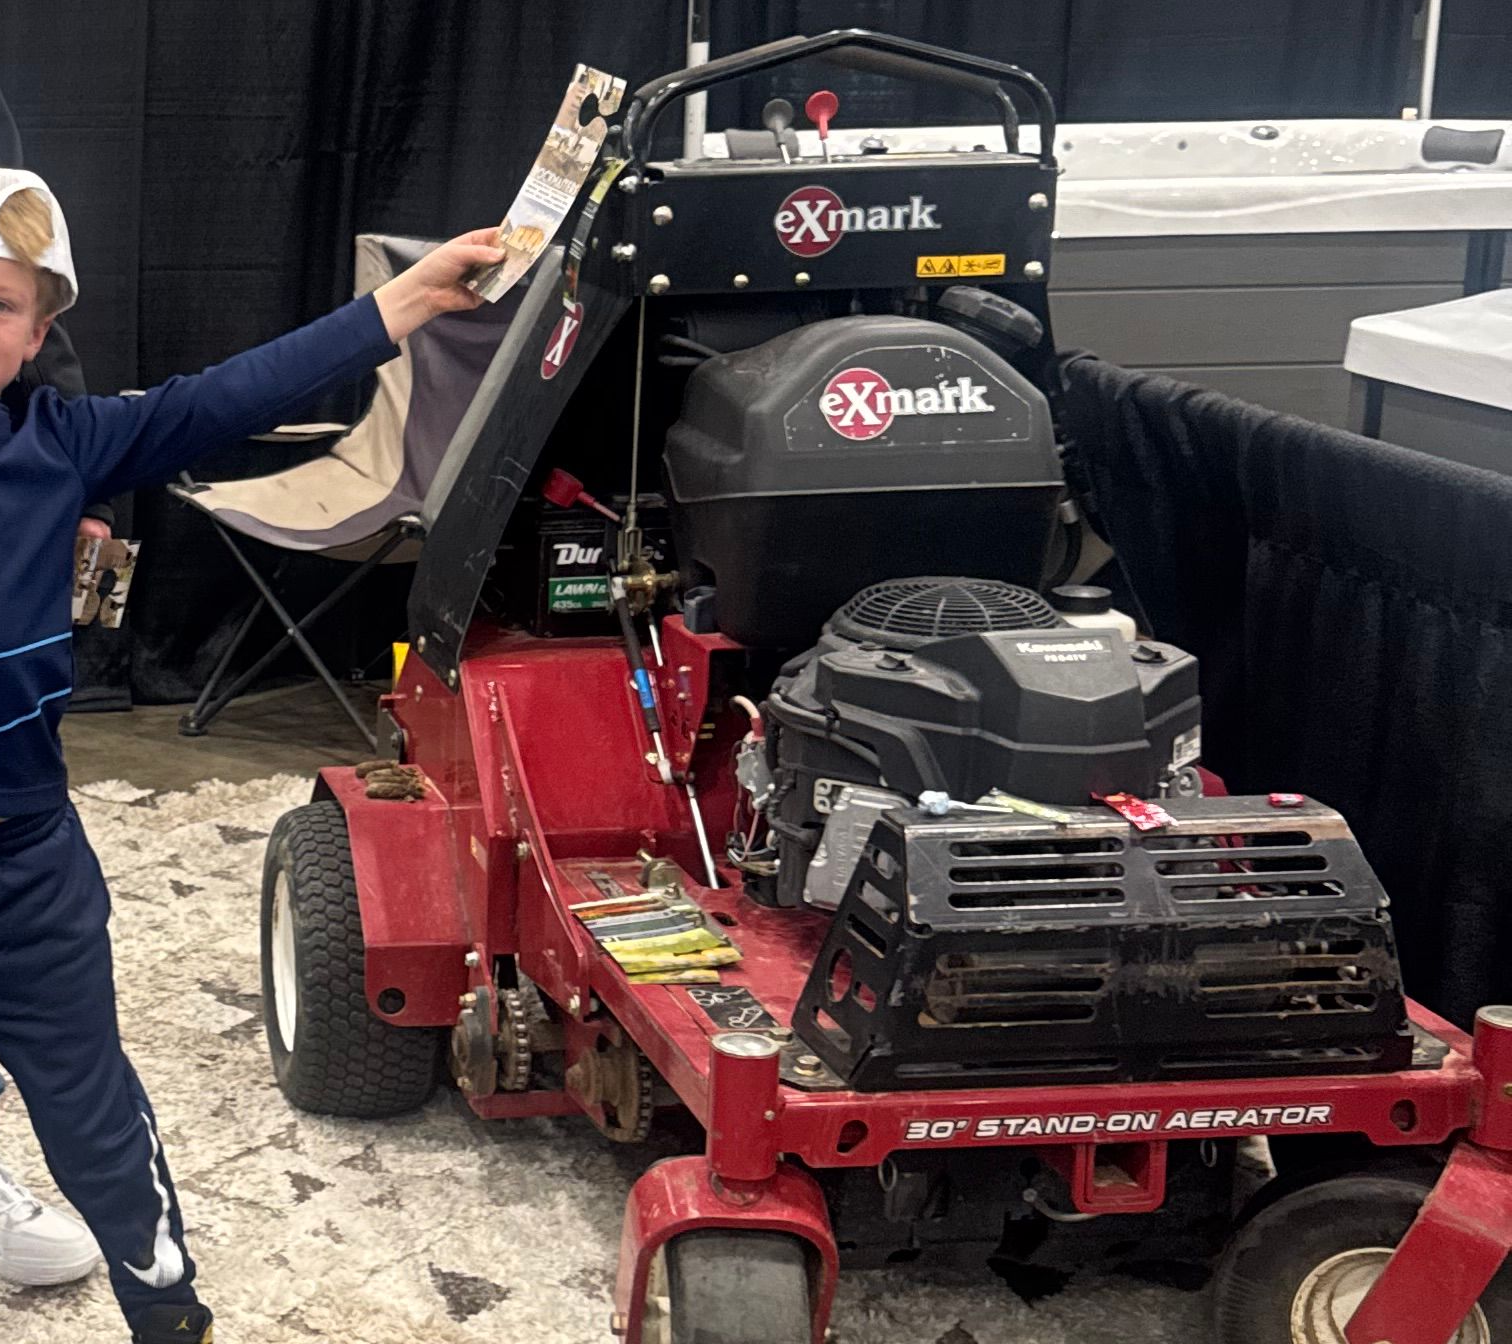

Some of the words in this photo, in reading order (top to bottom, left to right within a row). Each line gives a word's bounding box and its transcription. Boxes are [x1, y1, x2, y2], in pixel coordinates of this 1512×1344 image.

[554, 583, 599, 596] LAWN
[904, 1120, 967, 1141] 30"
[974, 1113, 1157, 1137] STAND-ON
[1164, 1105, 1332, 1130] AERATOR
